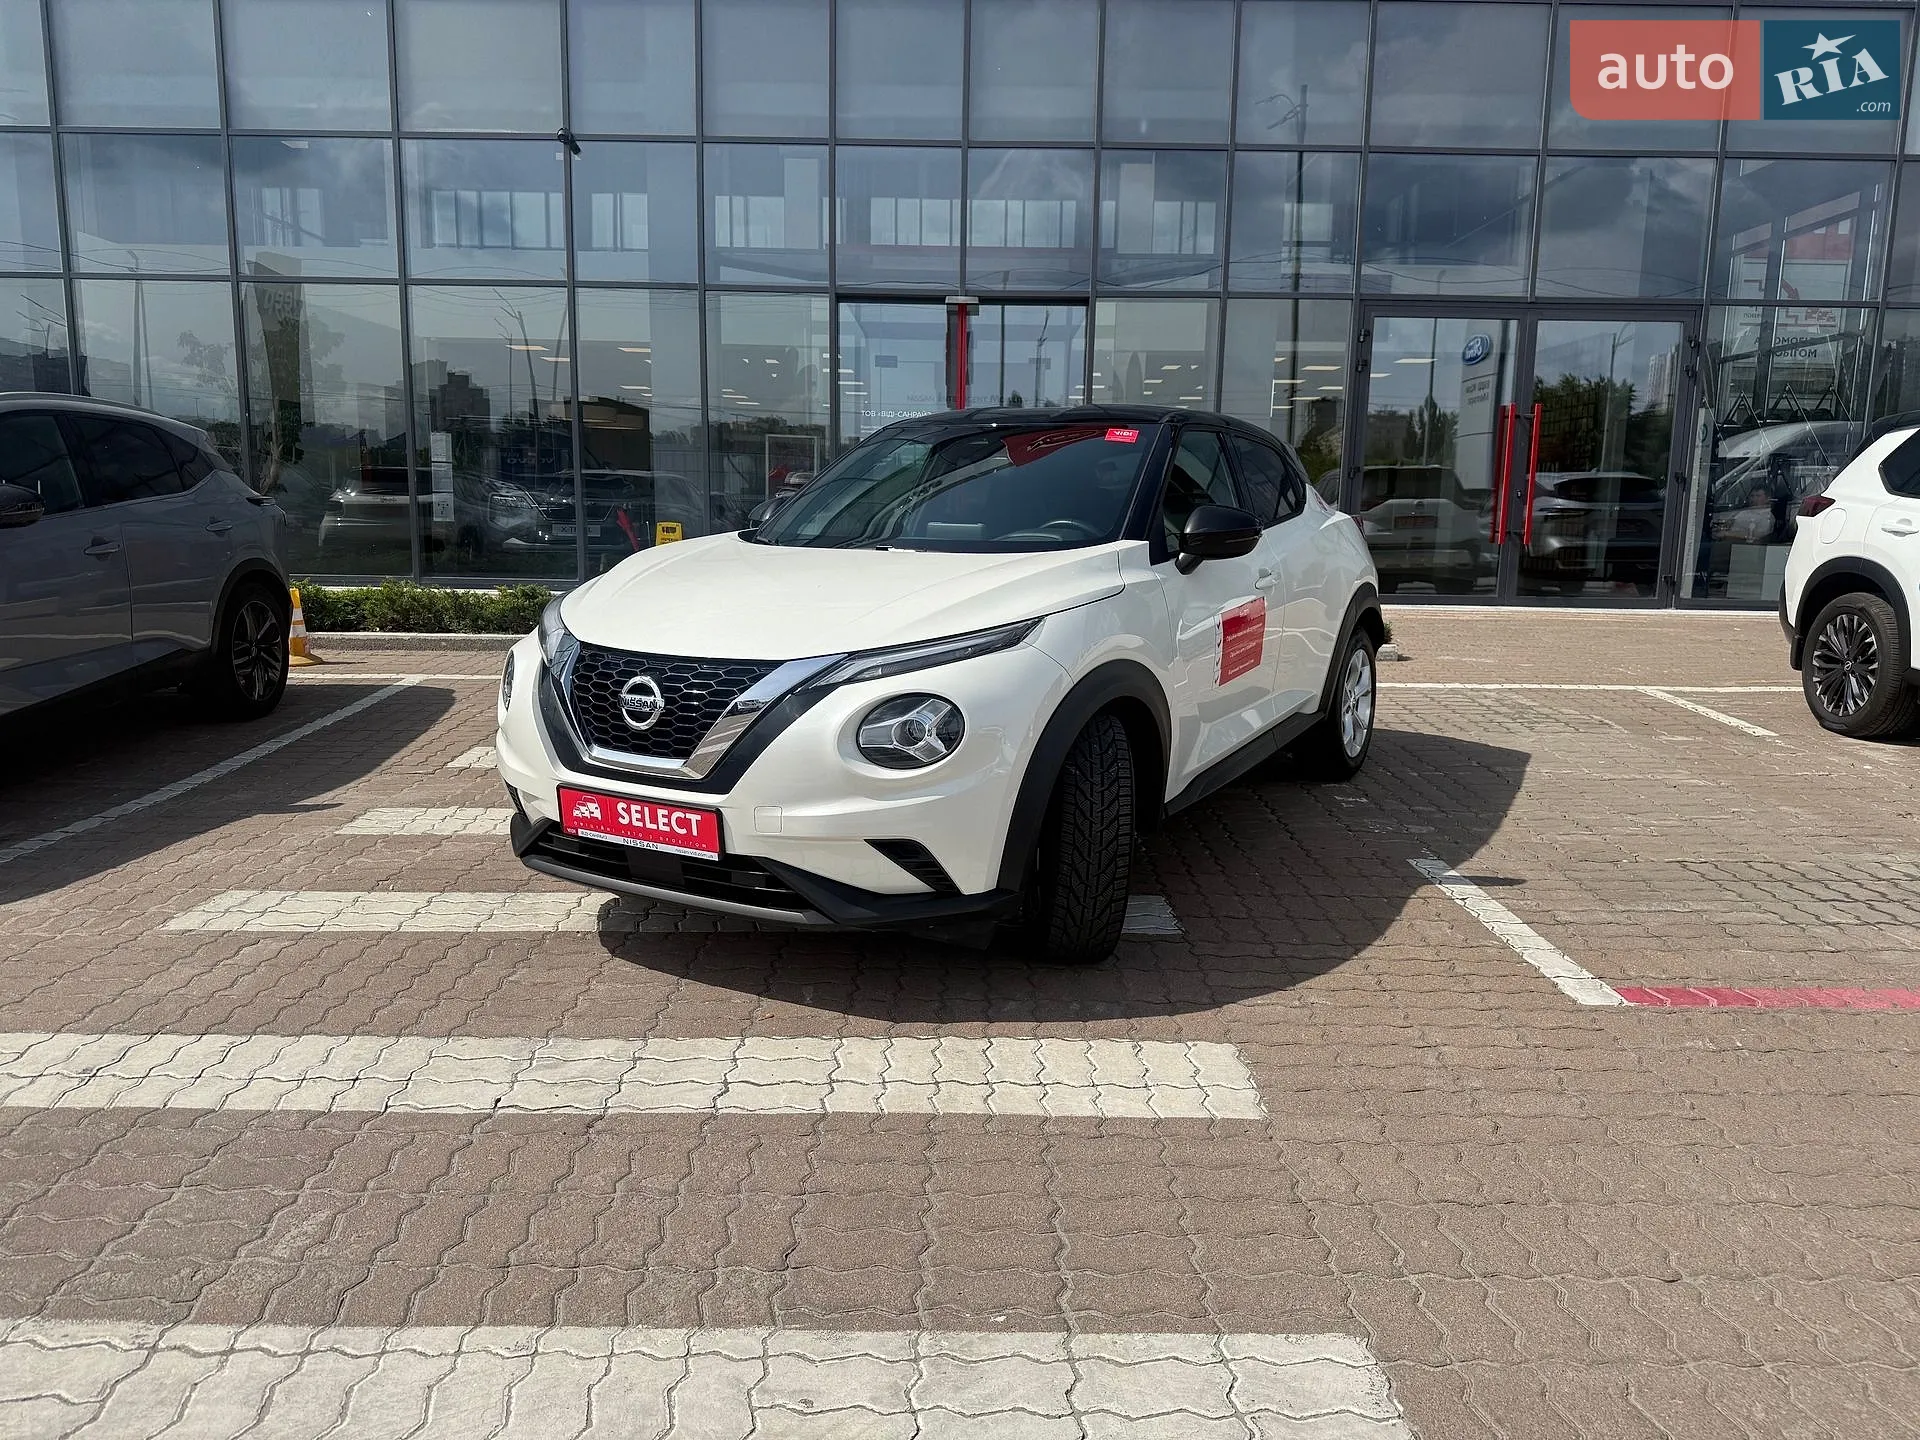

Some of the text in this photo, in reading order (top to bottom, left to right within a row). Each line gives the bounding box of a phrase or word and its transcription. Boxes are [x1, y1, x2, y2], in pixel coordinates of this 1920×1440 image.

[621, 698, 658, 709] NISSAN
[616, 802, 701, 837] SELECT
[622, 838, 659, 850] NISSAN
